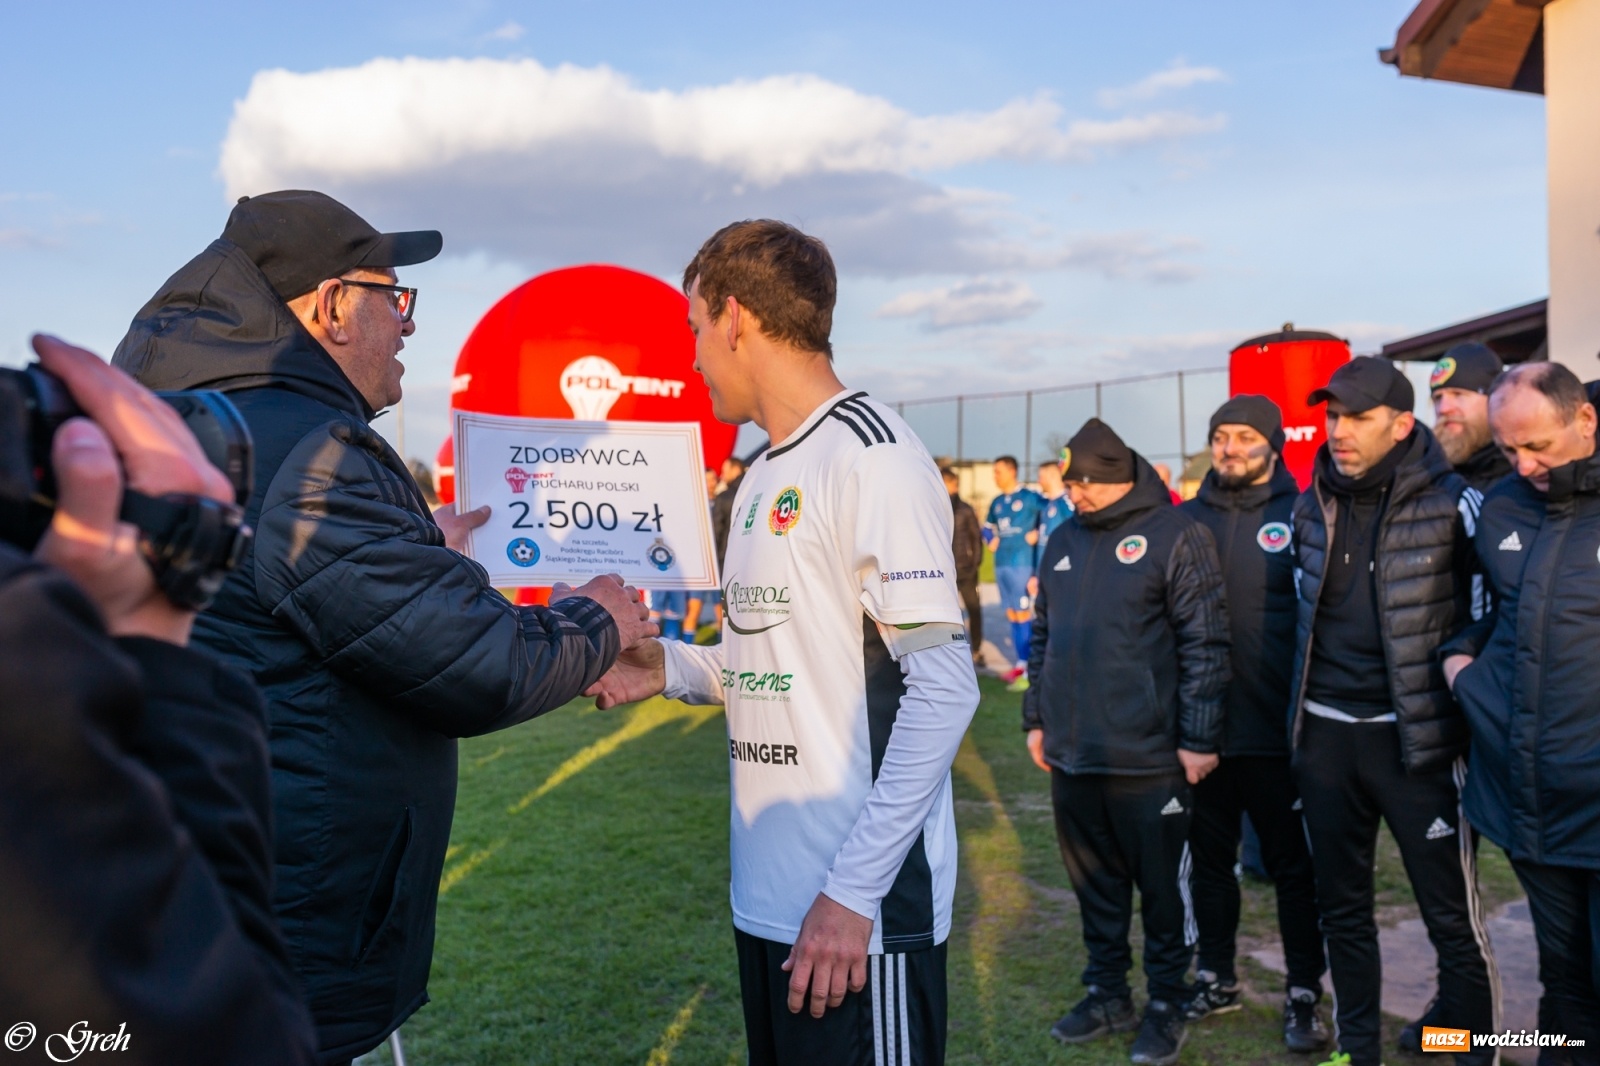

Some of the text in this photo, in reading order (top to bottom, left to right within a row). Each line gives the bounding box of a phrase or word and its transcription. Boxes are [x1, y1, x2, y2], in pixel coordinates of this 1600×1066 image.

[567, 375, 685, 398] POLTENT
[509, 445, 649, 466] ZDOBYWCA
[505, 472, 555, 480] POLTENT
[531, 479, 640, 492] PUCHARU POLSKI
[508, 500, 664, 533] 2.500 zł
[890, 570, 945, 581] GROTRAN
[730, 582, 791, 610] REKPOL
[739, 672, 794, 692] TRANS
